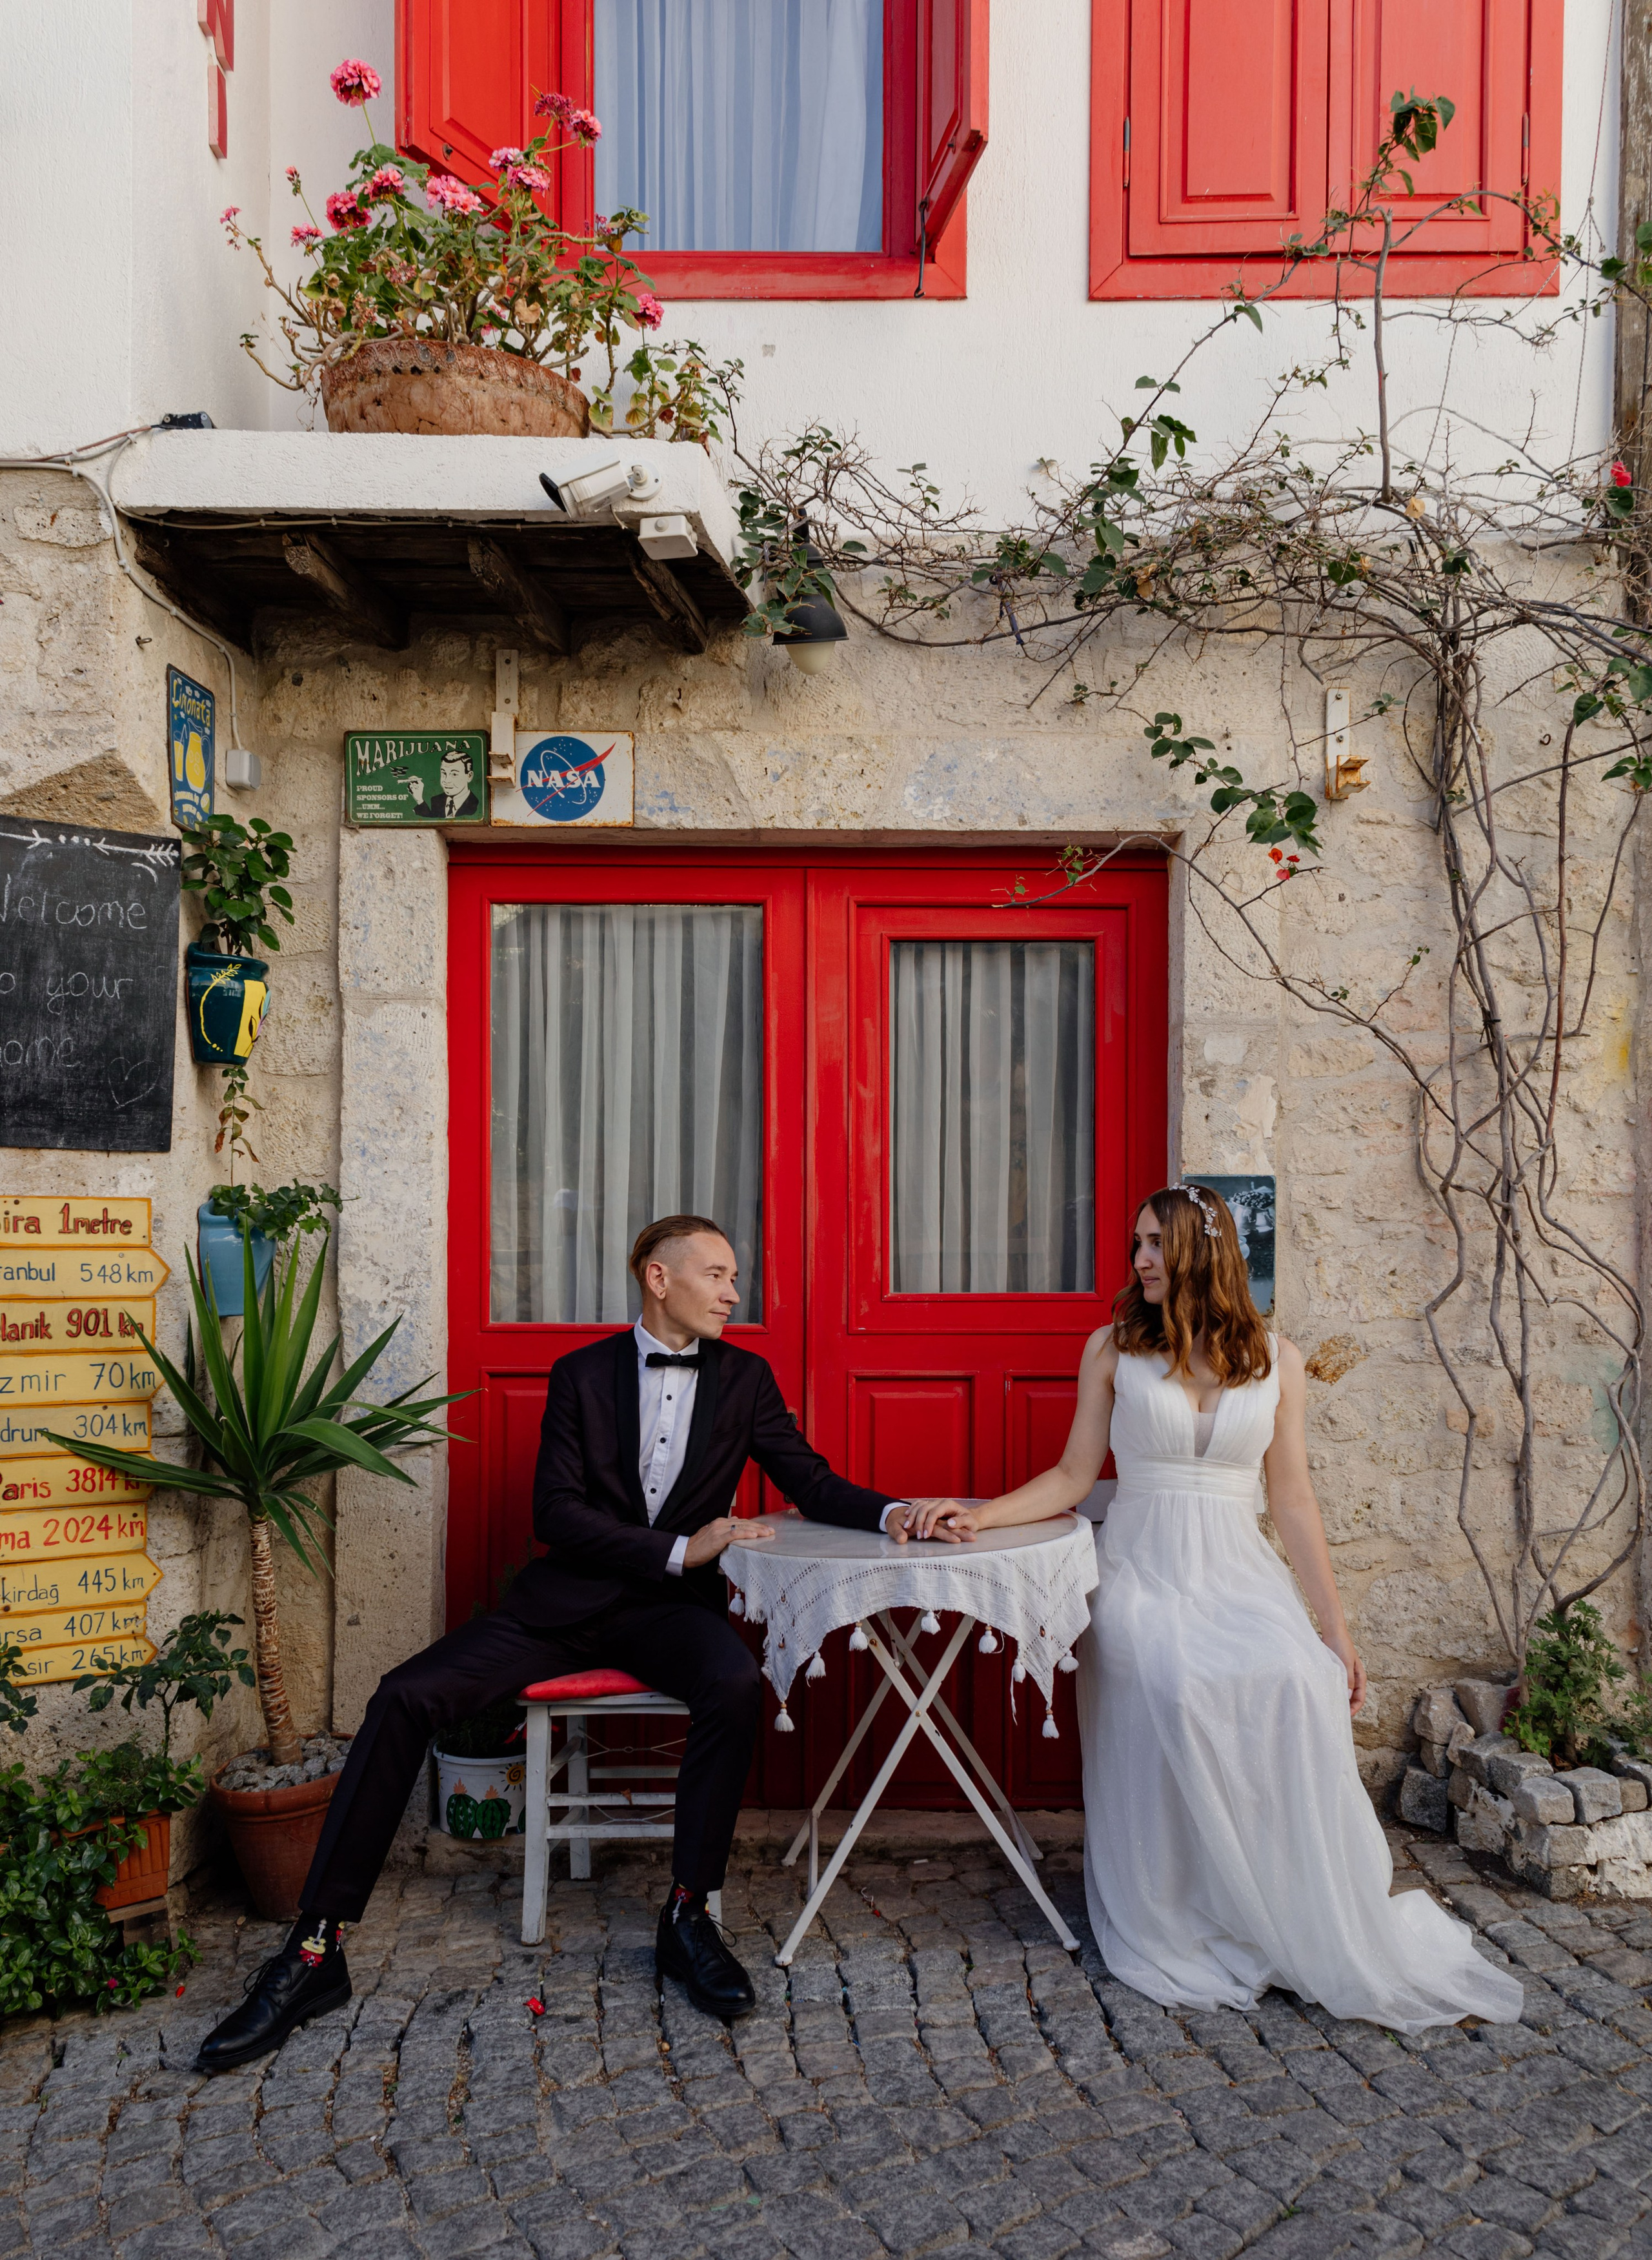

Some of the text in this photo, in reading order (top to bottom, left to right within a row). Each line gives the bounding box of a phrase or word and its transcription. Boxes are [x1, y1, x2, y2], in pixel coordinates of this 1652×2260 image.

[172, 679, 210, 727] Limonata
[355, 740, 471, 776] MARIJUANA
[527, 770, 601, 789] NASA
[47, 972, 134, 1014] your
[66, 1308, 113, 1338] 901
[89, 1362, 125, 1390] 70
[65, 1466, 119, 1493] 3814
[77, 1568, 117, 1594] 445
[63, 1611, 105, 1638] 407
